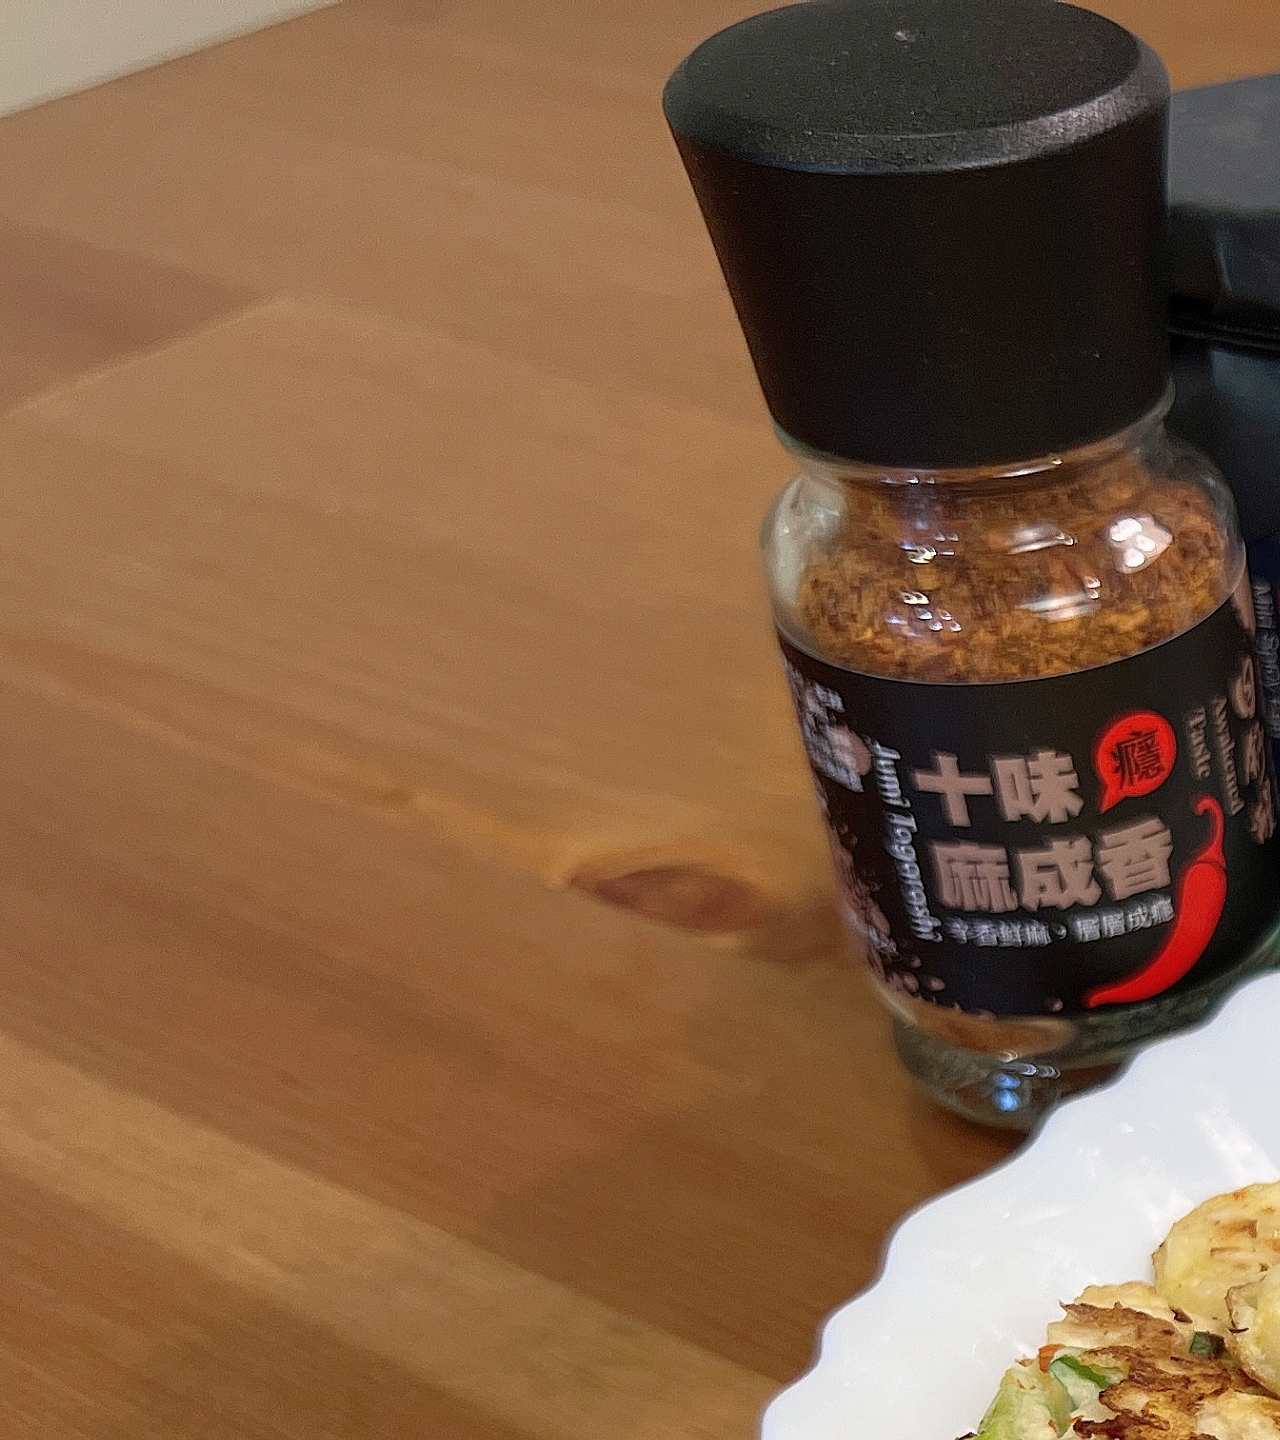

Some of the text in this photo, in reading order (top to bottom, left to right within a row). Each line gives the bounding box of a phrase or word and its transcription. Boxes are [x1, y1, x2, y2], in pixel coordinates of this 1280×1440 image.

[914, 749, 1085, 827] 十味
[930, 815, 1174, 914] 麻成香
